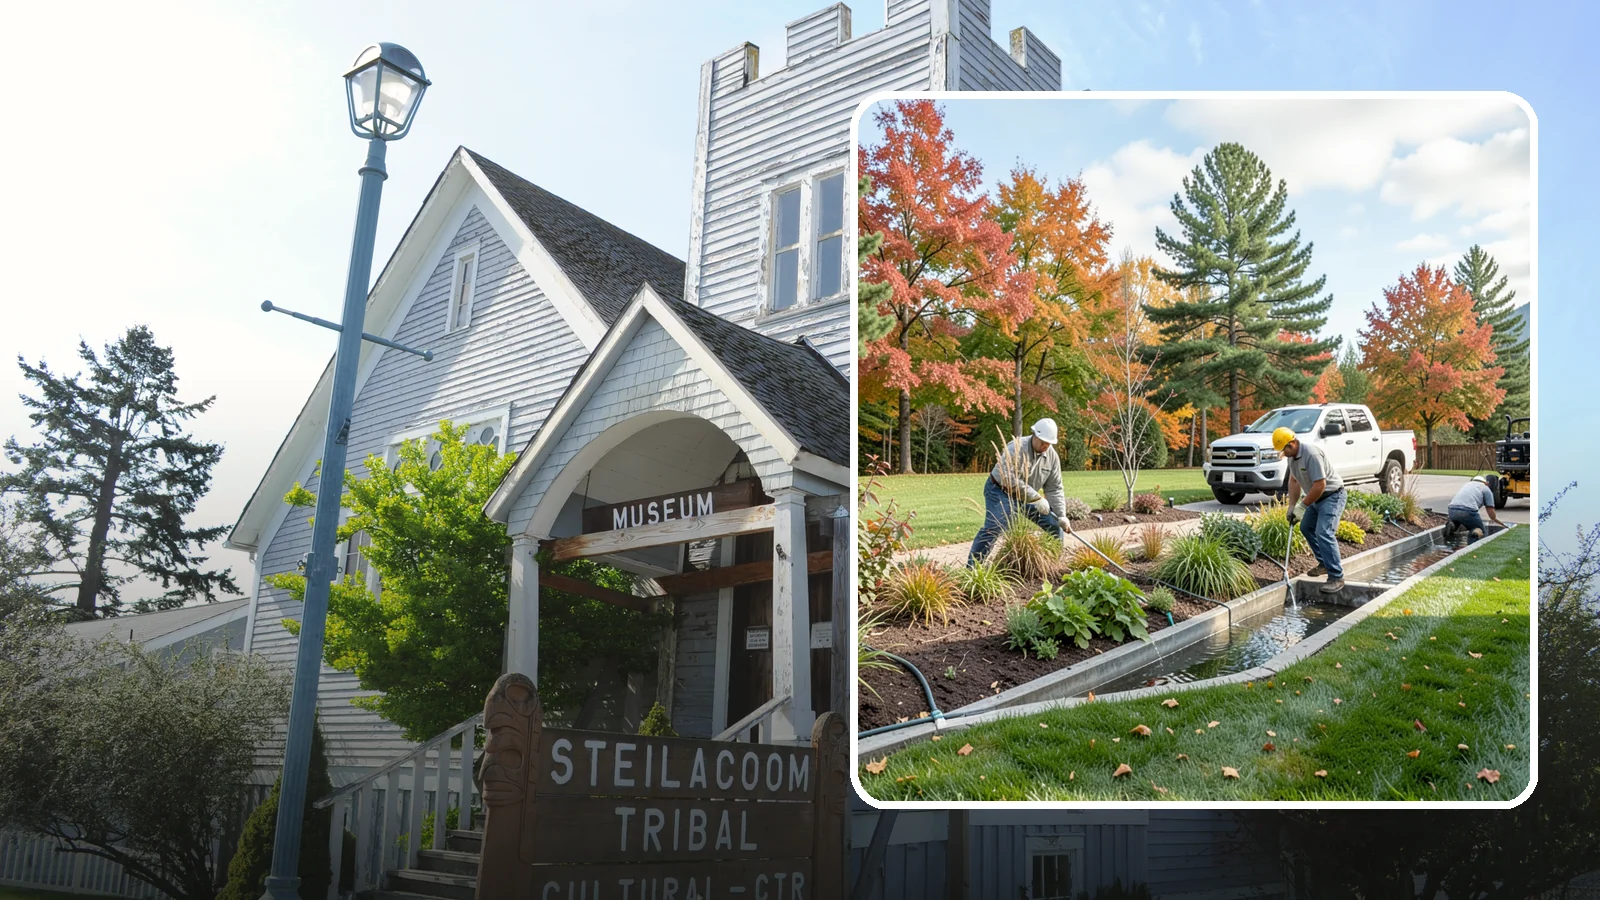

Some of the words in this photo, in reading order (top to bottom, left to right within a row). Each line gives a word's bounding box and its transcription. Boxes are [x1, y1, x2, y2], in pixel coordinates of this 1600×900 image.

[613, 492, 713, 530] MUSEUM
[550, 738, 809, 792] STEILACOOM
[615, 807, 758, 851] TRIBAL
